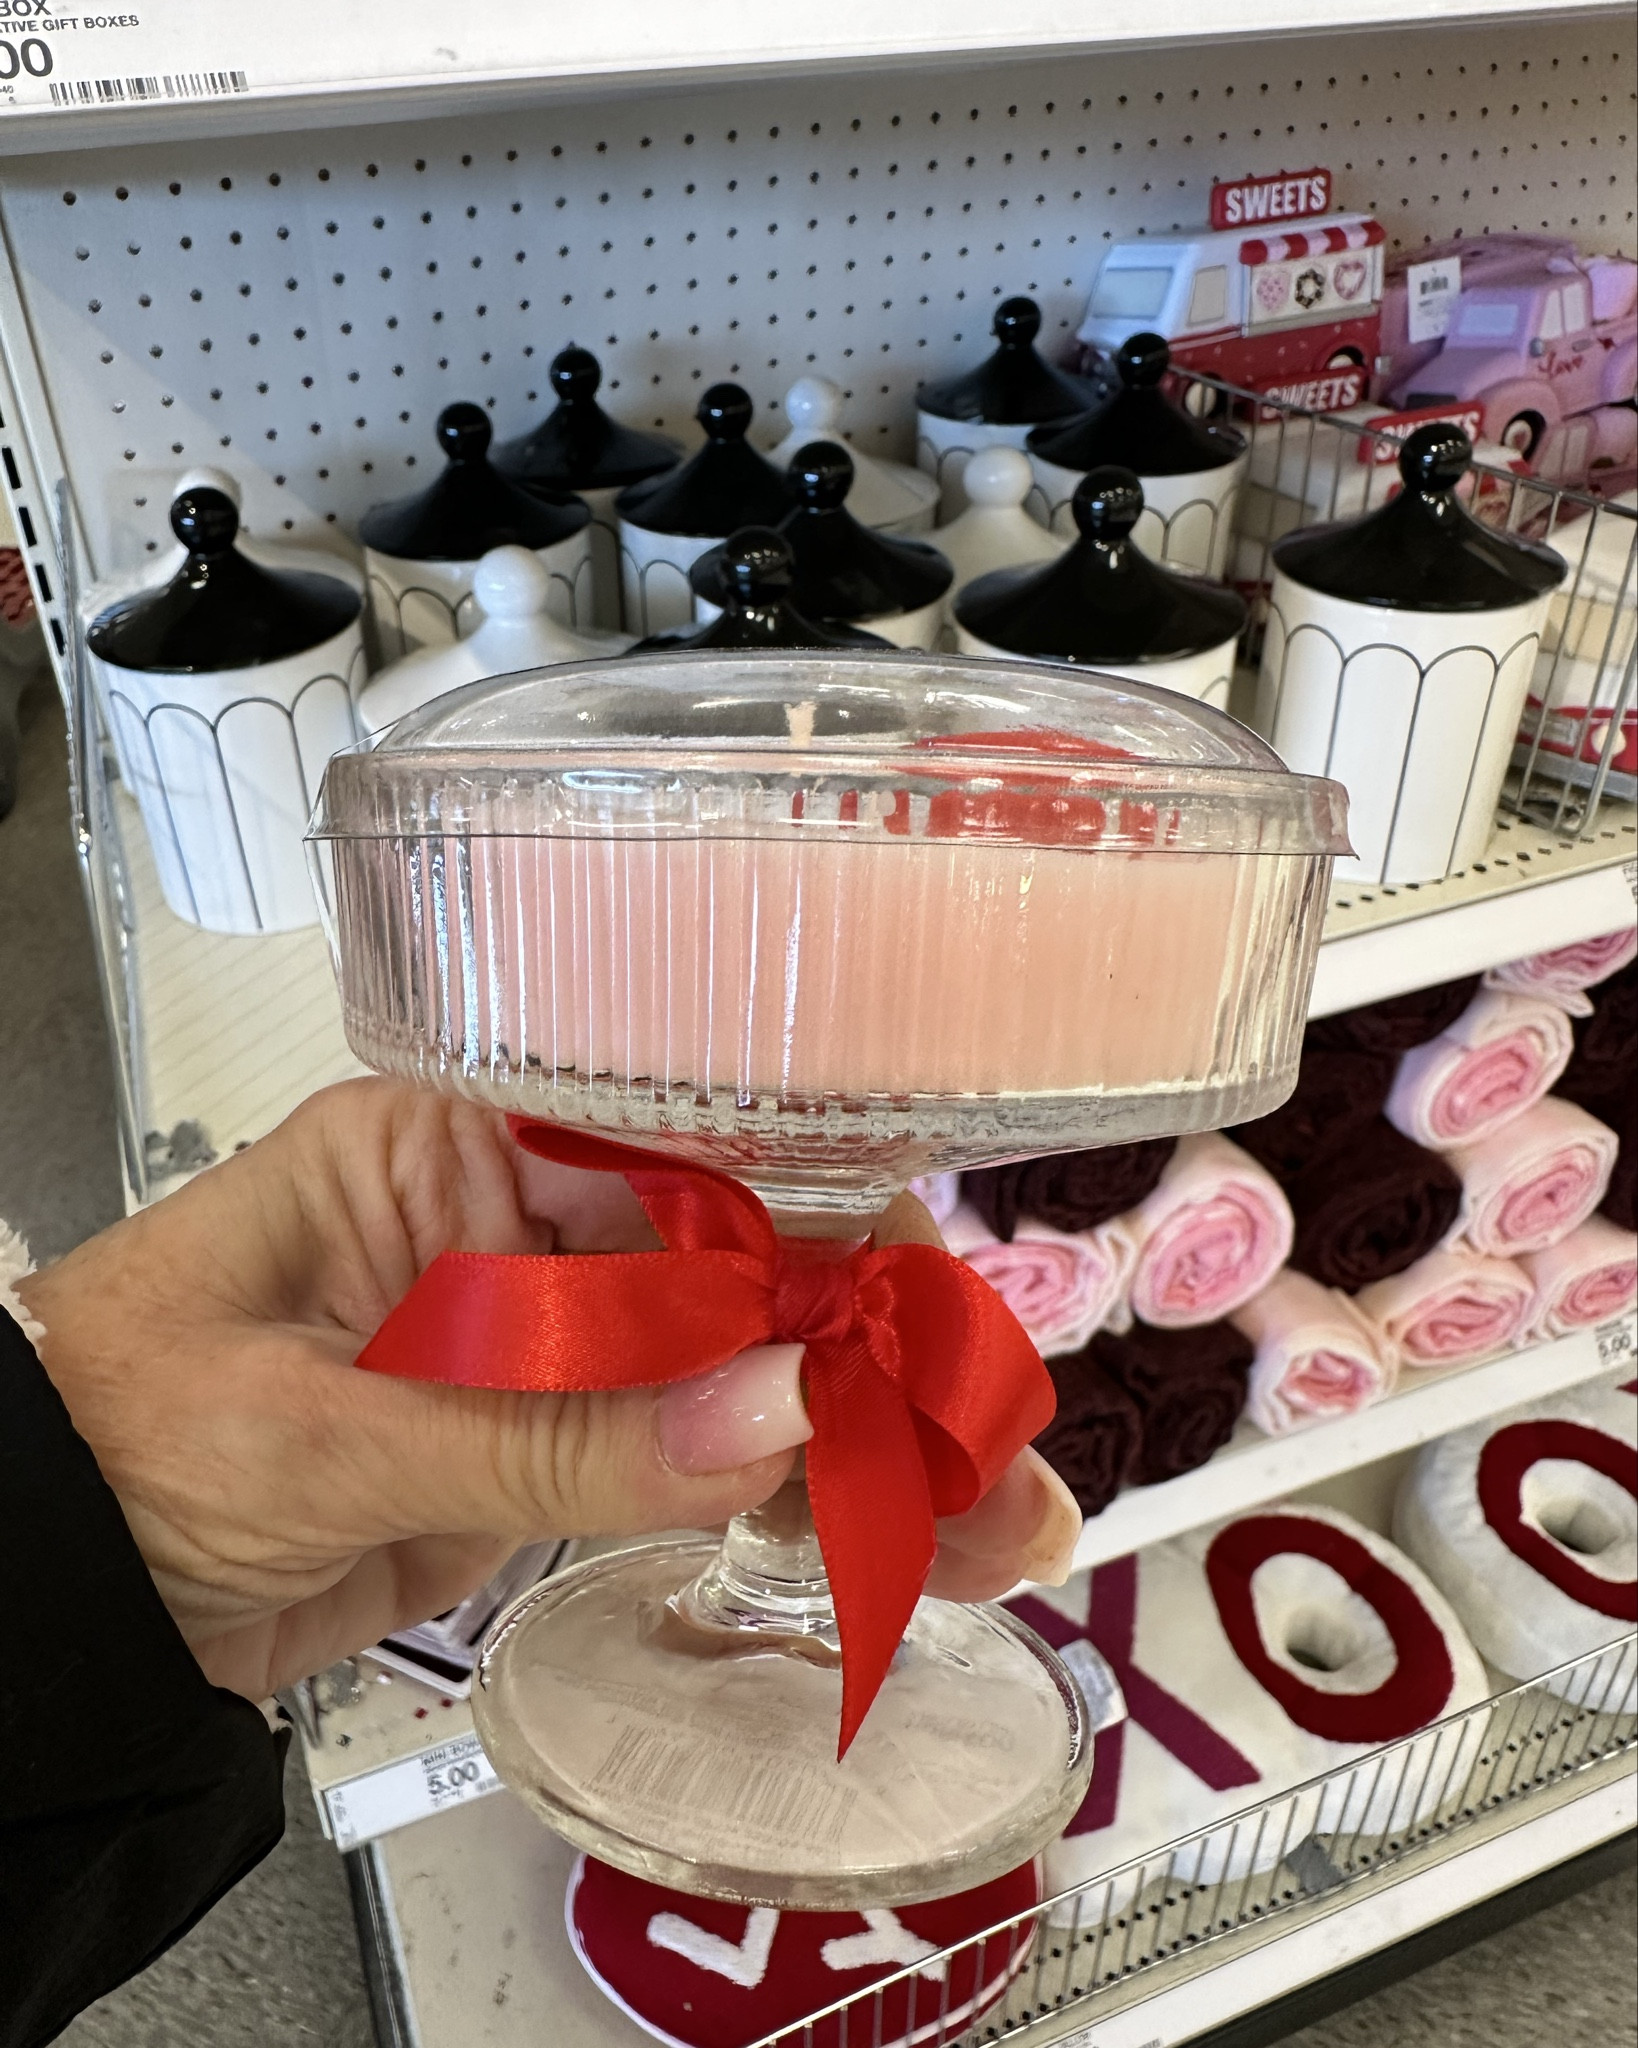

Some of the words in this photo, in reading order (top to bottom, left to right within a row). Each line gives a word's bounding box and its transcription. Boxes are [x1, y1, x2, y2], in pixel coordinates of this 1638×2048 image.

[42, 18, 79, 31] GIFT
[83, 15, 140, 29] BOXES
[1225, 175, 1327, 223] SWEETS
[1261, 374, 1360, 419] SWEETS
[427, 1760, 480, 1796] 5.00
